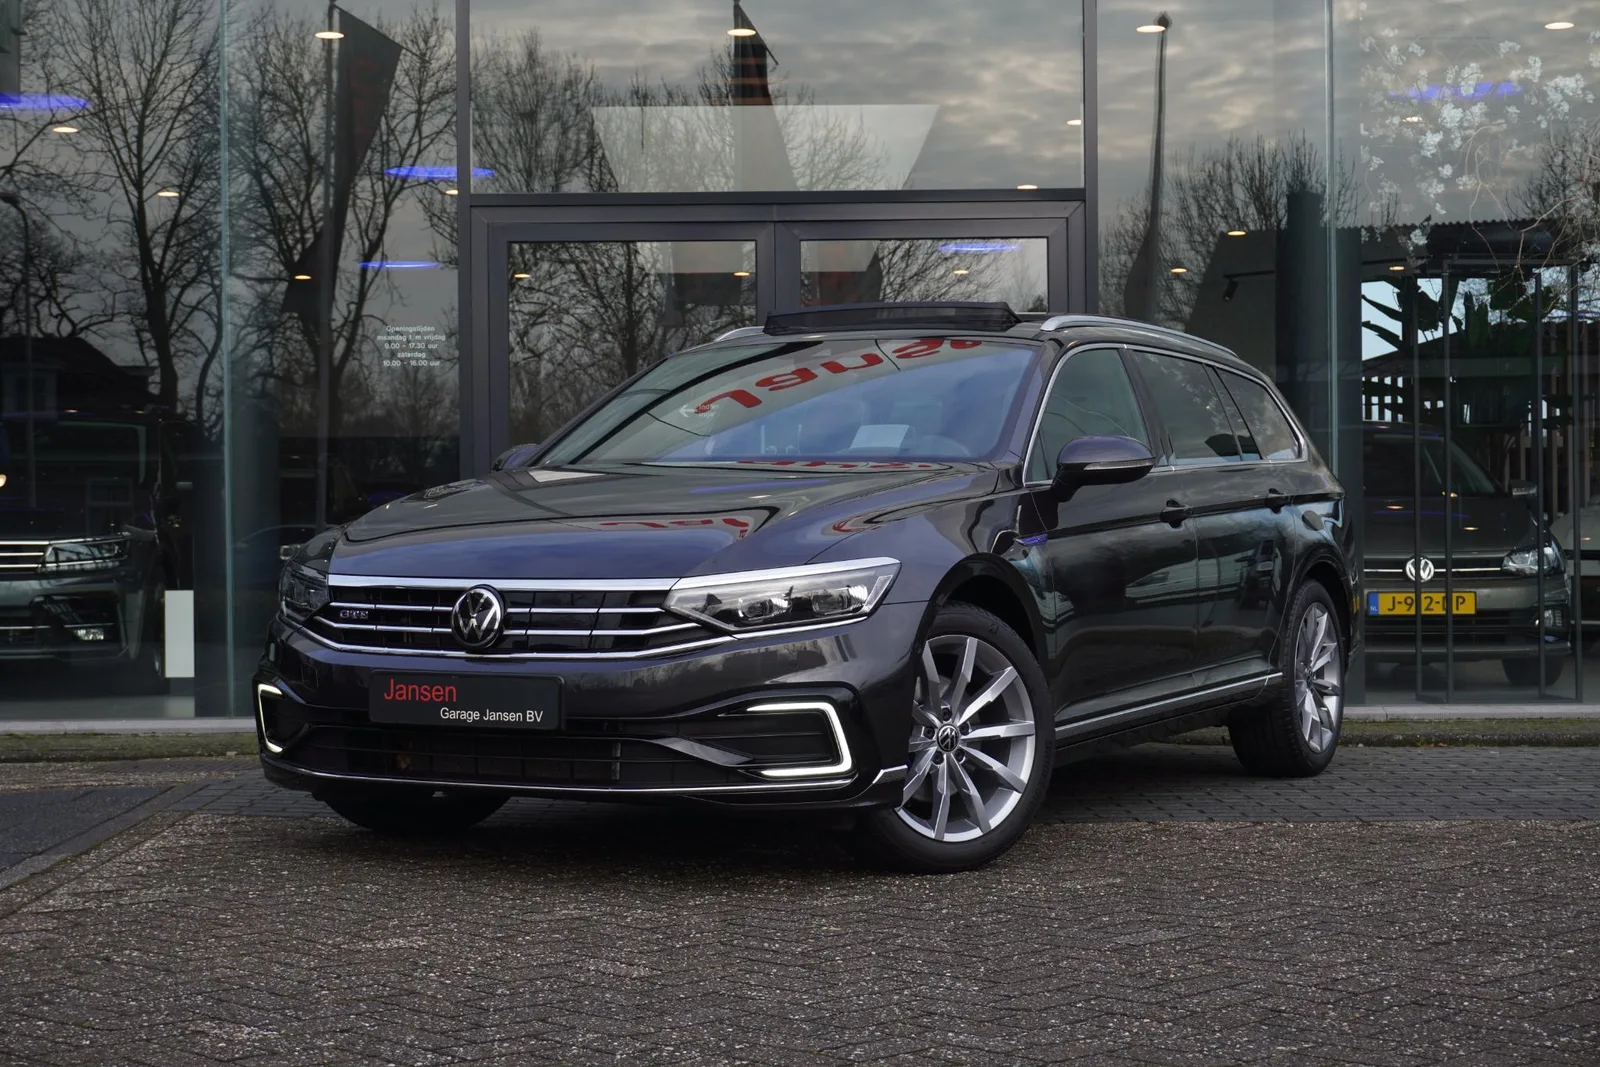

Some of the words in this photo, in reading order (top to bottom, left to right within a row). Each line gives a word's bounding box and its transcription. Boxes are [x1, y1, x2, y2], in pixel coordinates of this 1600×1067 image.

[340, 610, 369, 619] GTE
[383, 678, 457, 702] Jansen
[440, 707, 480, 723] Garage
[483, 709, 523, 722] Jansen
[526, 710, 544, 723] BV
